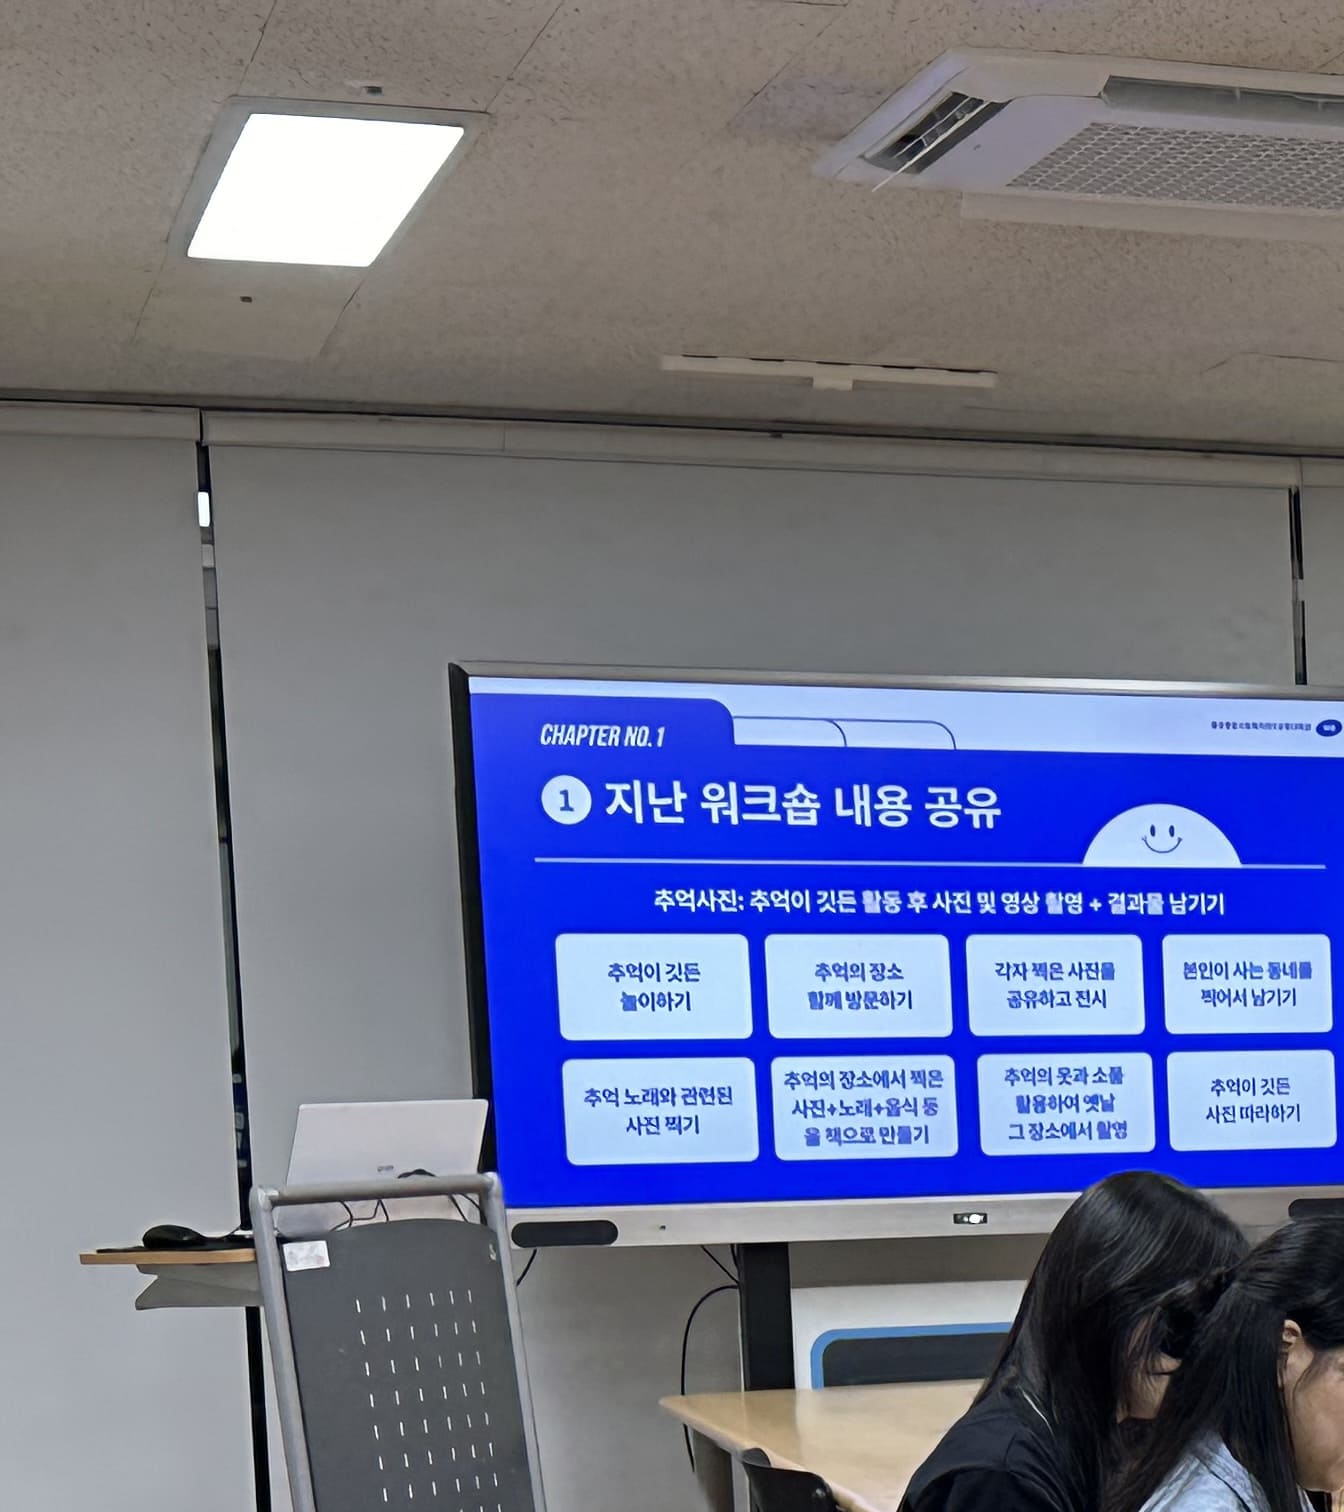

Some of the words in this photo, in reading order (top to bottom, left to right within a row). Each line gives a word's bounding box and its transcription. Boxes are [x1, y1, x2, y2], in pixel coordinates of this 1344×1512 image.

[540, 723, 621, 747] CHAPTER
[624, 724, 653, 748] NO.
[656, 725, 666, 748] 1
[605, 779, 688, 825] 지난
[700, 781, 822, 827] 워크숍
[835, 783, 913, 828] 내용
[924, 784, 1002, 829] 공유
[654, 888, 745, 913] 추억사진:
[750, 889, 811, 913] 추억이
[816, 889, 857, 914] 깃든
[906, 889, 928, 914] 후
[932, 889, 972, 915] 사진
[976, 890, 996, 915] 및
[1001, 890, 1040, 915] 영상
[1089, 898, 1102, 911] +
[1169, 892, 1225, 916] 남기기
[608, 962, 661, 983] 추억이
[666, 962, 701, 983] 깃든
[815, 961, 866, 983] 추억의
[869, 961, 904, 982] 장소
[995, 961, 1027, 981] 각자
[1031, 962, 1064, 981] 찍은
[1068, 961, 1116, 981] 사진
[1183, 961, 1229, 981] 본인이
[1233, 961, 1264, 981] 사는
[1267, 961, 1313, 981] 동네
[845, 990, 913, 1011] 방문하기
[1007, 989, 1072, 1010] 공유하고
[1075, 988, 1107, 1009] 전시
[1201, 988, 1247, 1008] 찍어서
[1251, 987, 1297, 1008] 남기기
[784, 1069, 835, 1090] 추억의
[839, 1068, 906, 1090] 장소에서
[910, 1069, 944, 1089] 찍은
[1004, 1066, 1053, 1087] 추억의
[1211, 1076, 1256, 1098] 추억이
[1260, 1077, 1291, 1096] 깃든
[583, 1087, 620, 1107] 추억
[624, 1087, 677, 1107] 노래와
[681, 1085, 734, 1106] 관련된
[626, 1115, 661, 1136] 사진
[665, 1114, 700, 1136] 찍기
[1206, 1104, 1236, 1125] 사진
[1239, 1103, 1301, 1124] 따라하기
[879, 1124, 929, 1145] 만기
[1008, 1123, 1025, 1140] 그
[1028, 1120, 1093, 1141] 장소에서
